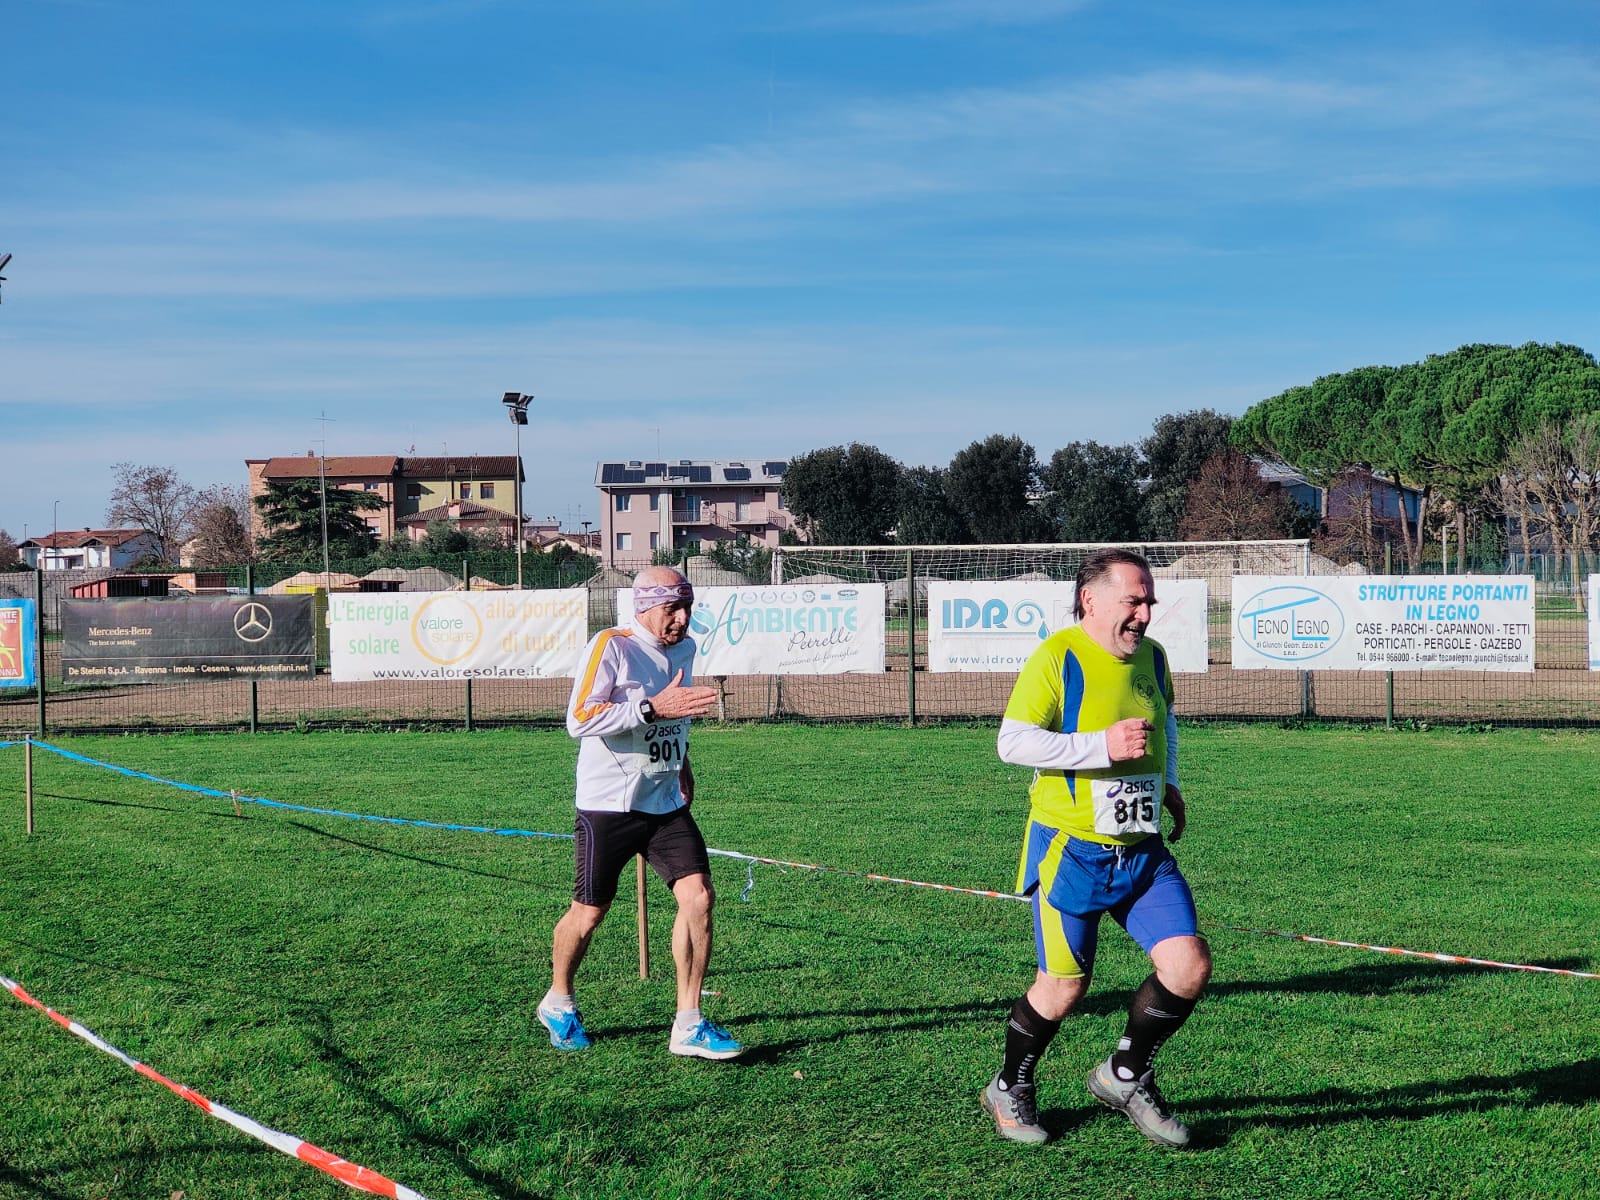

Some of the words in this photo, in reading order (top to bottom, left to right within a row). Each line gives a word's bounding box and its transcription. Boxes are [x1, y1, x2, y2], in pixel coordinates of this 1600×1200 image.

[1359, 585, 1447, 600] STRUTTURE
[1452, 585, 1529, 600] PORTANTI
[333, 600, 409, 625] L'Energia
[486, 600, 516, 619] alla
[522, 599, 585, 621] portata
[1406, 605, 1423, 620] IN
[1427, 604, 1480, 620] LEGNO
[420, 616, 464, 630] valore
[1356, 623, 1382, 635] CASE
[1391, 623, 1427, 635] PARCHI
[1436, 623, 1494, 635] CAPANNONI
[1503, 623, 1530, 635] TETTI
[89, 627, 152, 636] Mercedes-Benz
[432, 632, 474, 643] solare
[787, 627, 853, 651] Petrelli
[349, 633, 399, 655] solare
[502, 634, 519, 653] di
[525, 634, 561, 652] tutti
[1364, 638, 1415, 650] PORTICATI
[1424, 638, 1471, 650] PERGOLE
[1480, 638, 1522, 650] GAZEBO
[1357, 652, 1367, 661] Tel.
[69, 666, 80, 675] De
[80, 666, 107, 675] Stefani
[135, 665, 167, 674] Ravenna
[173, 664, 195, 674] Imola
[201, 664, 230, 673] Cesena
[236, 663, 309, 673] www.destefani.net
[373, 665, 543, 679] www.valoresolare.it
[658, 724, 682, 737] asics
[649, 738, 681, 763] 901
[1125, 779, 1156, 794] asics
[1114, 796, 1153, 824] 815
